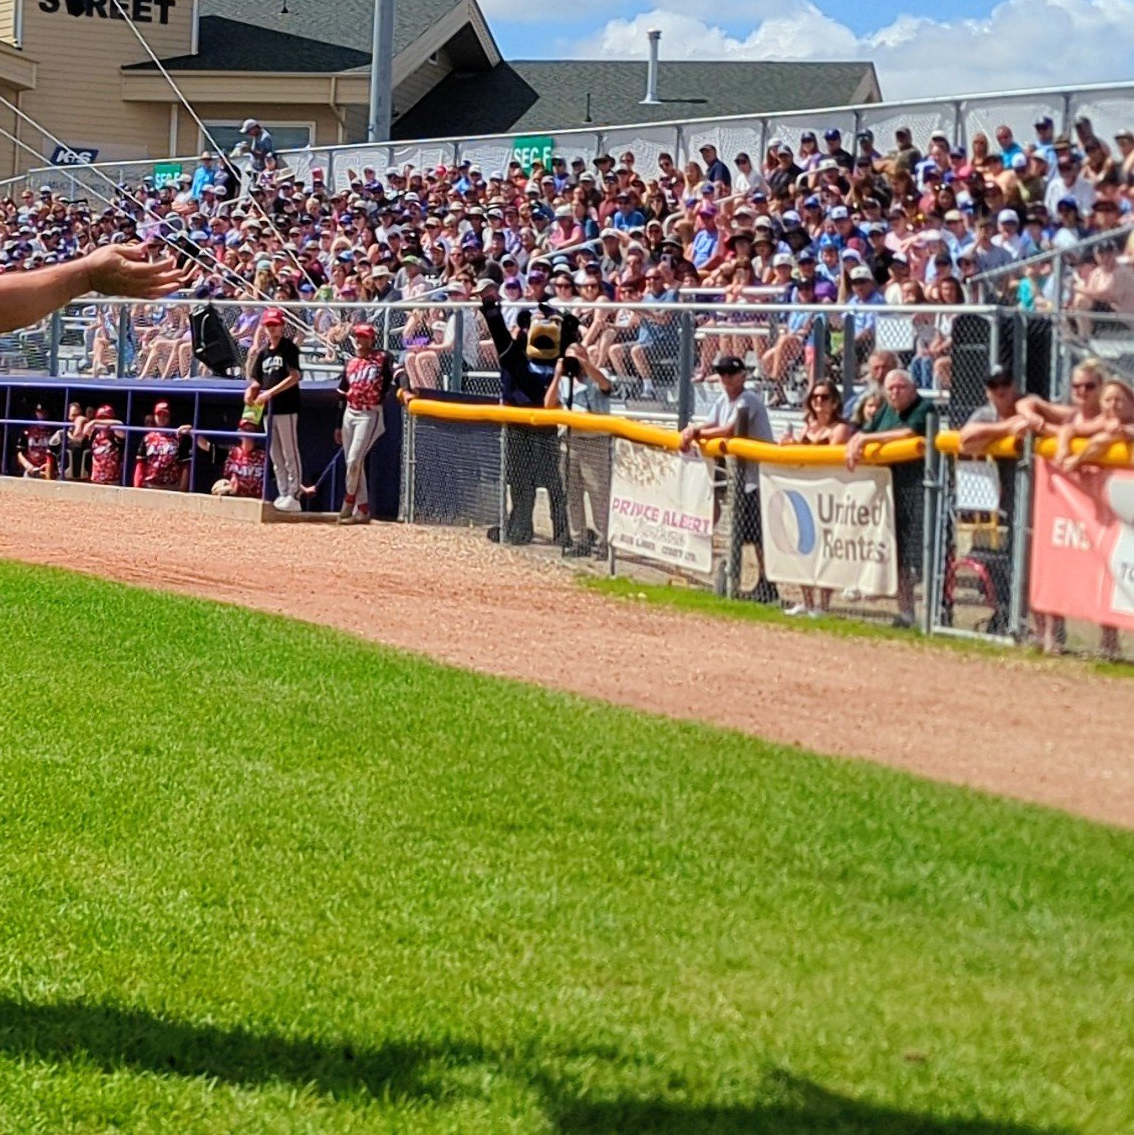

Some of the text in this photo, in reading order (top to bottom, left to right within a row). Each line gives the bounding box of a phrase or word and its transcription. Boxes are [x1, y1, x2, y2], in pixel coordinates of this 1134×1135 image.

[514, 146, 551, 168] SEC F
[612, 497, 659, 523] PRINCE
[818, 493, 883, 527] United
[823, 528, 889, 564] Rentas
